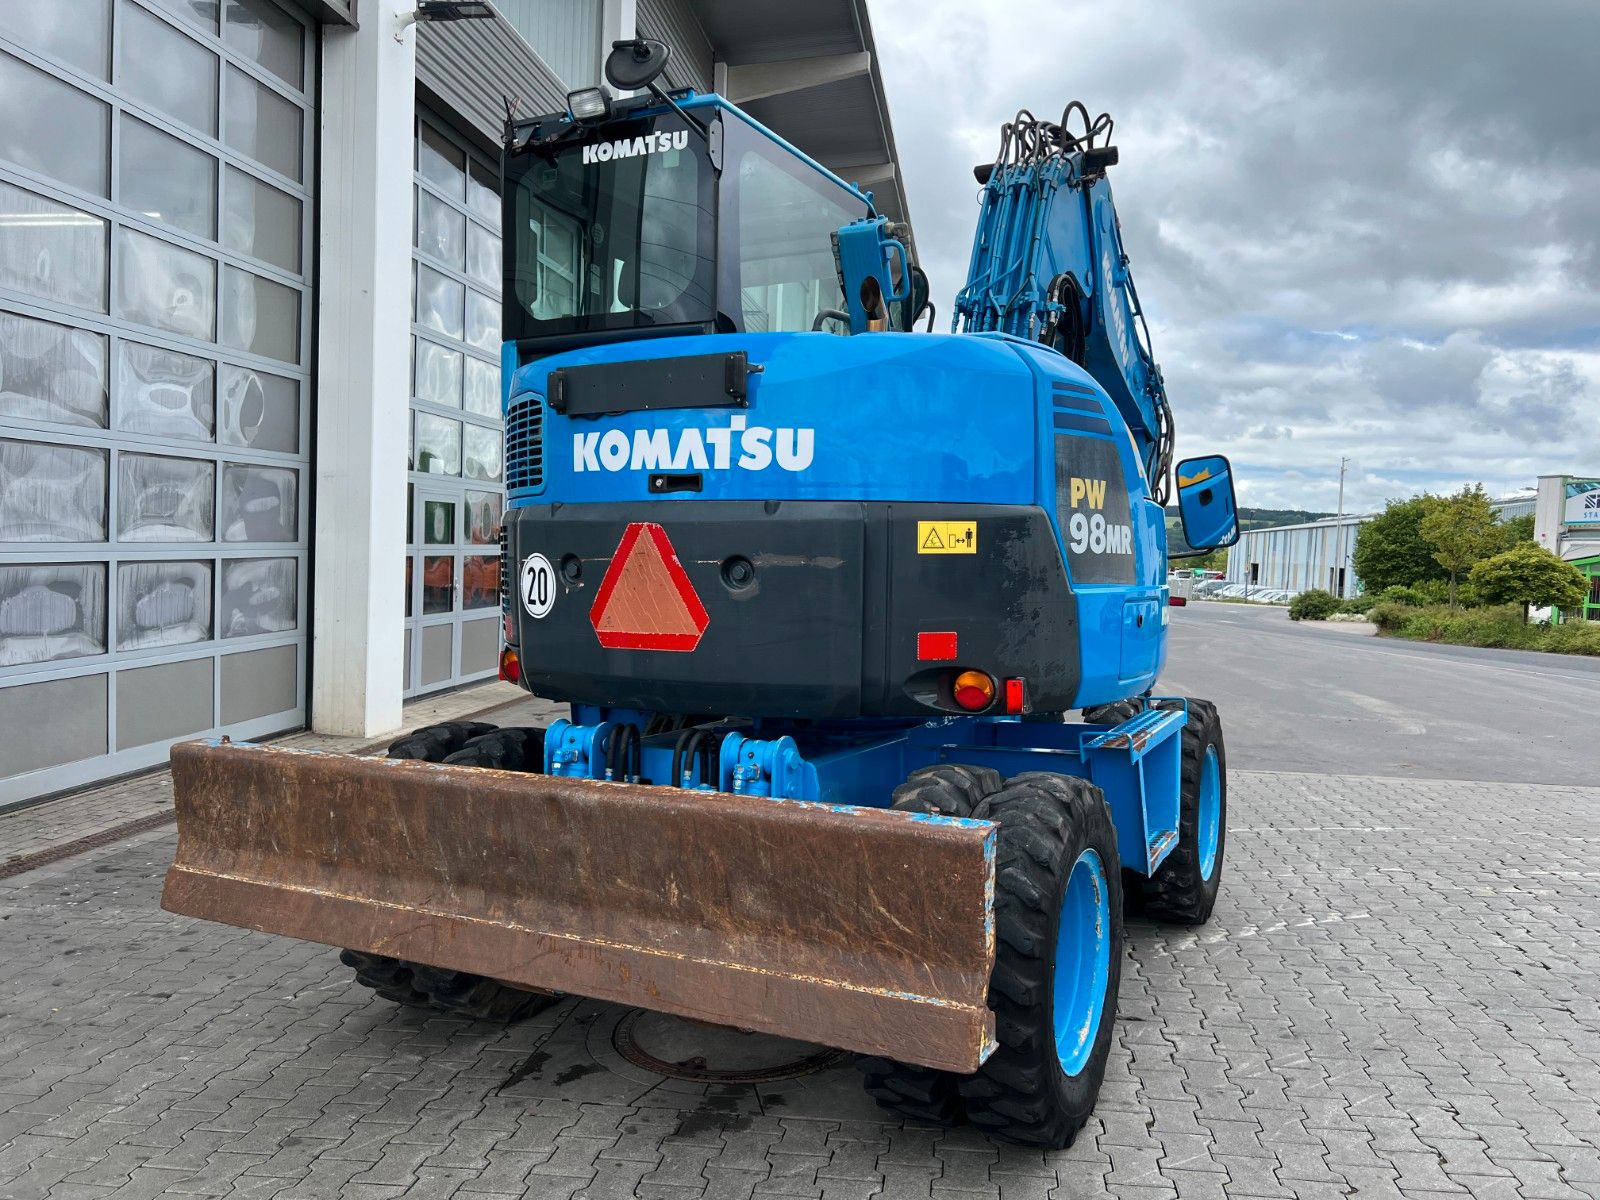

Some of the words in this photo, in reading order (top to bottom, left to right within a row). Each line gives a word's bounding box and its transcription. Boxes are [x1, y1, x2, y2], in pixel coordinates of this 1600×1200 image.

[582, 130, 688, 165] KOMATSU
[573, 414, 815, 473] KOMATSU
[1070, 477, 1107, 510] PW
[1069, 512, 1133, 555] 98MR
[527, 566, 548, 606] 20
